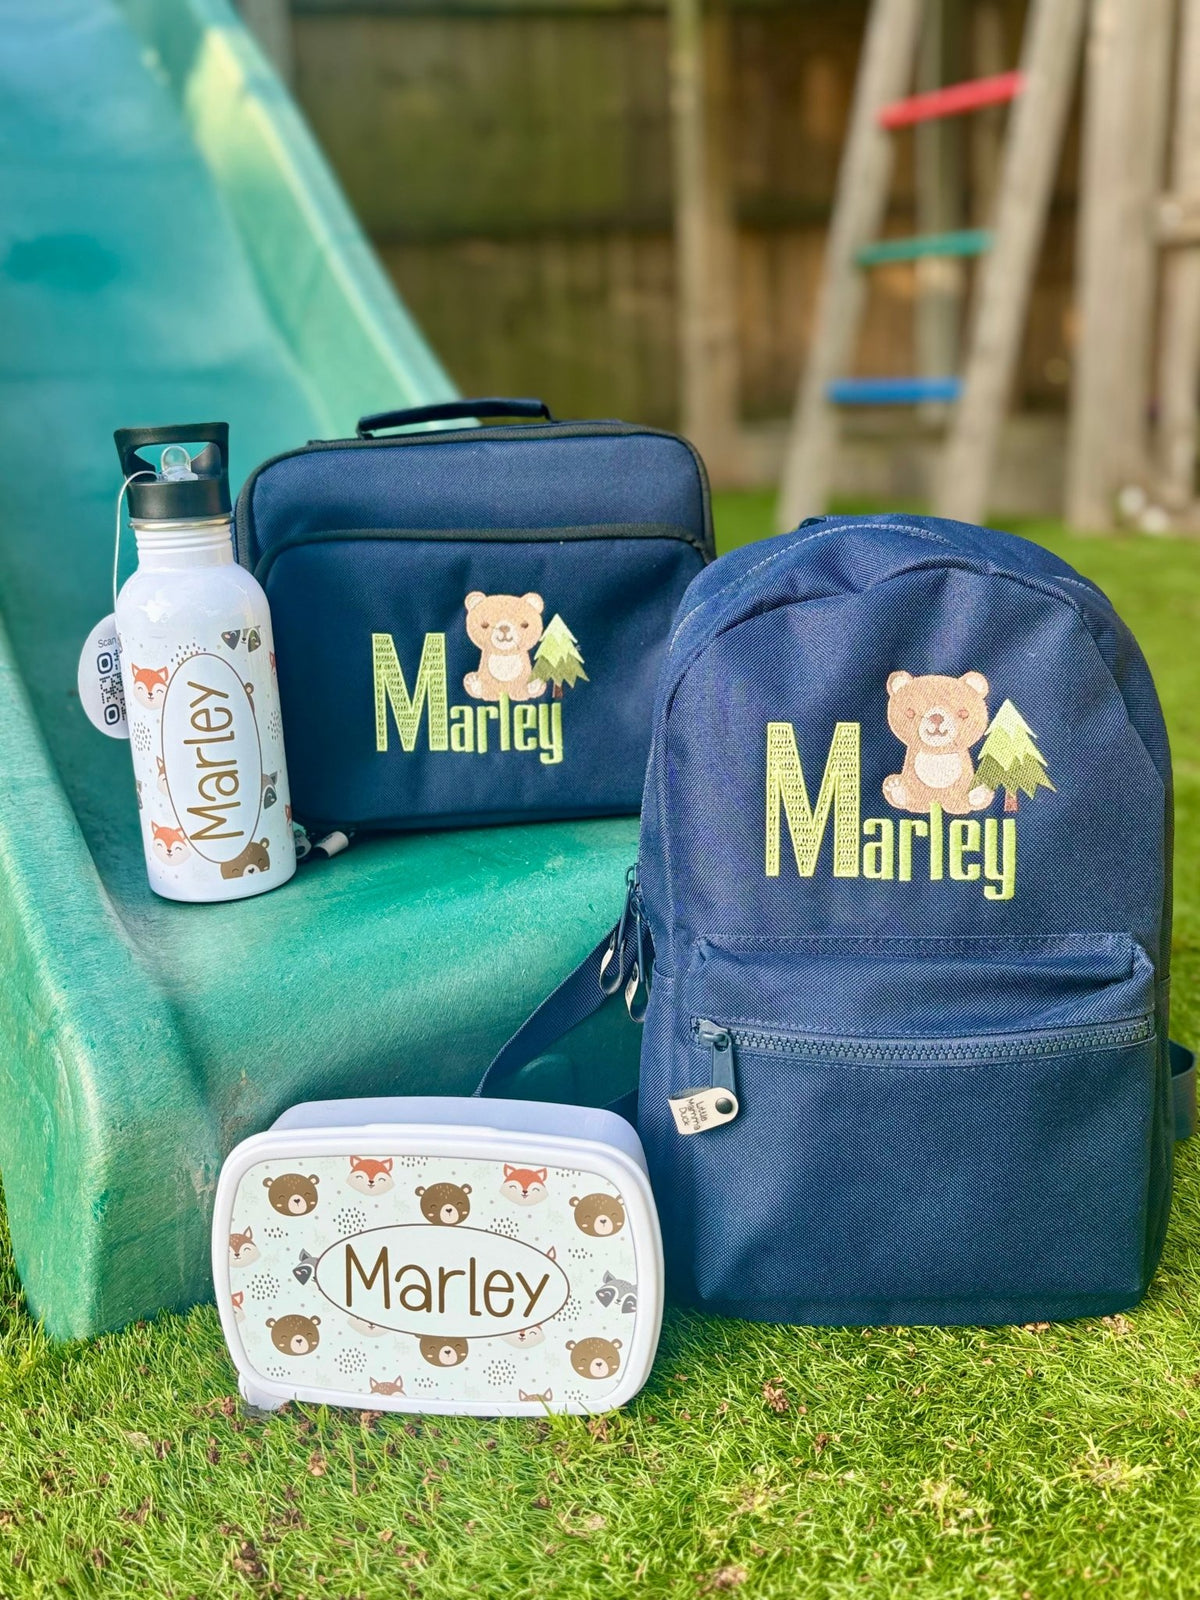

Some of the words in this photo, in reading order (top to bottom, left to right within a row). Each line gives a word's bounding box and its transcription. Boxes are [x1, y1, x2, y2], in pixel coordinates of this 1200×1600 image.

[97, 637, 117, 649] Scan
[372, 632, 564, 765] Marley
[183, 680, 245, 841] Marley
[765, 722, 1016, 901] Marley
[679, 1107, 690, 1126] Duck
[345, 1243, 550, 1318] Marley
